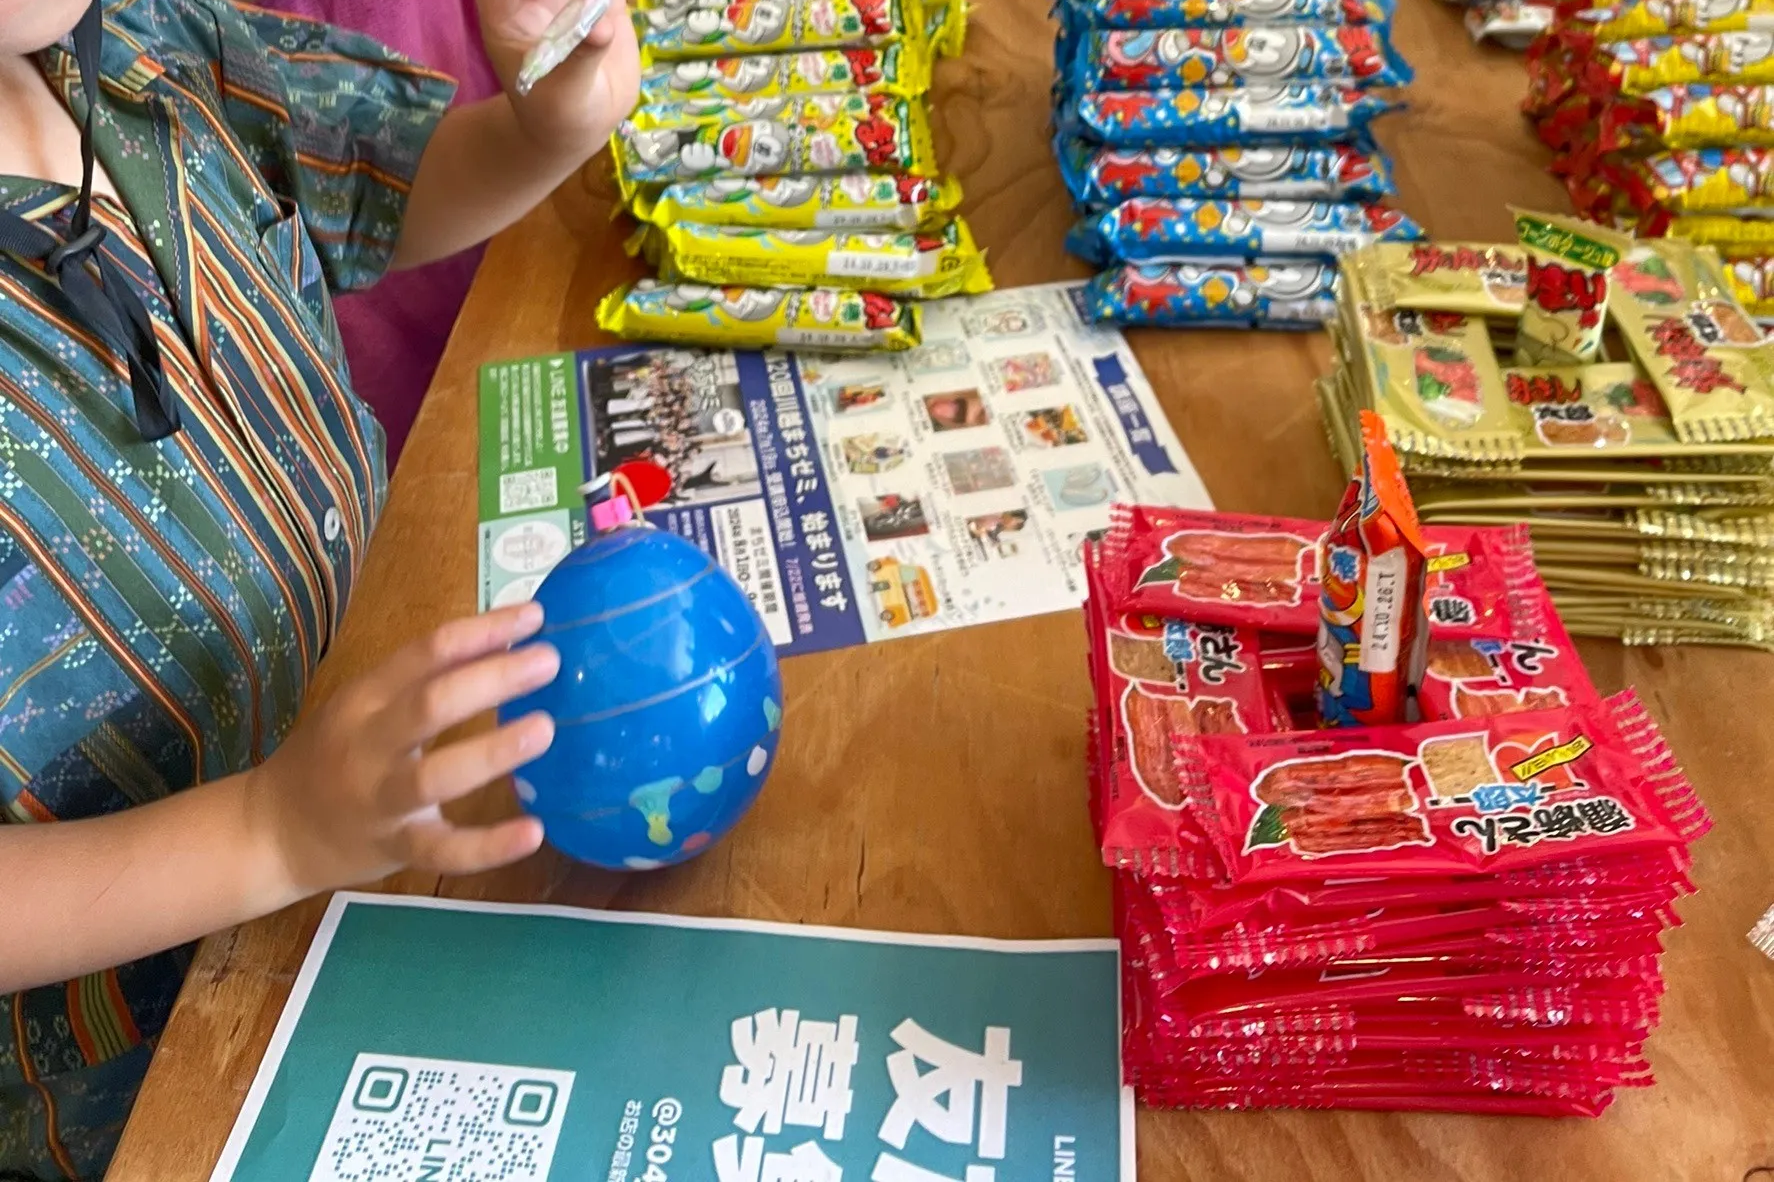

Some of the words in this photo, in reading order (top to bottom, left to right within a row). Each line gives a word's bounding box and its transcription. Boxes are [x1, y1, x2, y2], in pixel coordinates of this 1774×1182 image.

[1471, 783, 1540, 813] 太郎
[1453, 799, 1631, 853] 蒲焼さん
